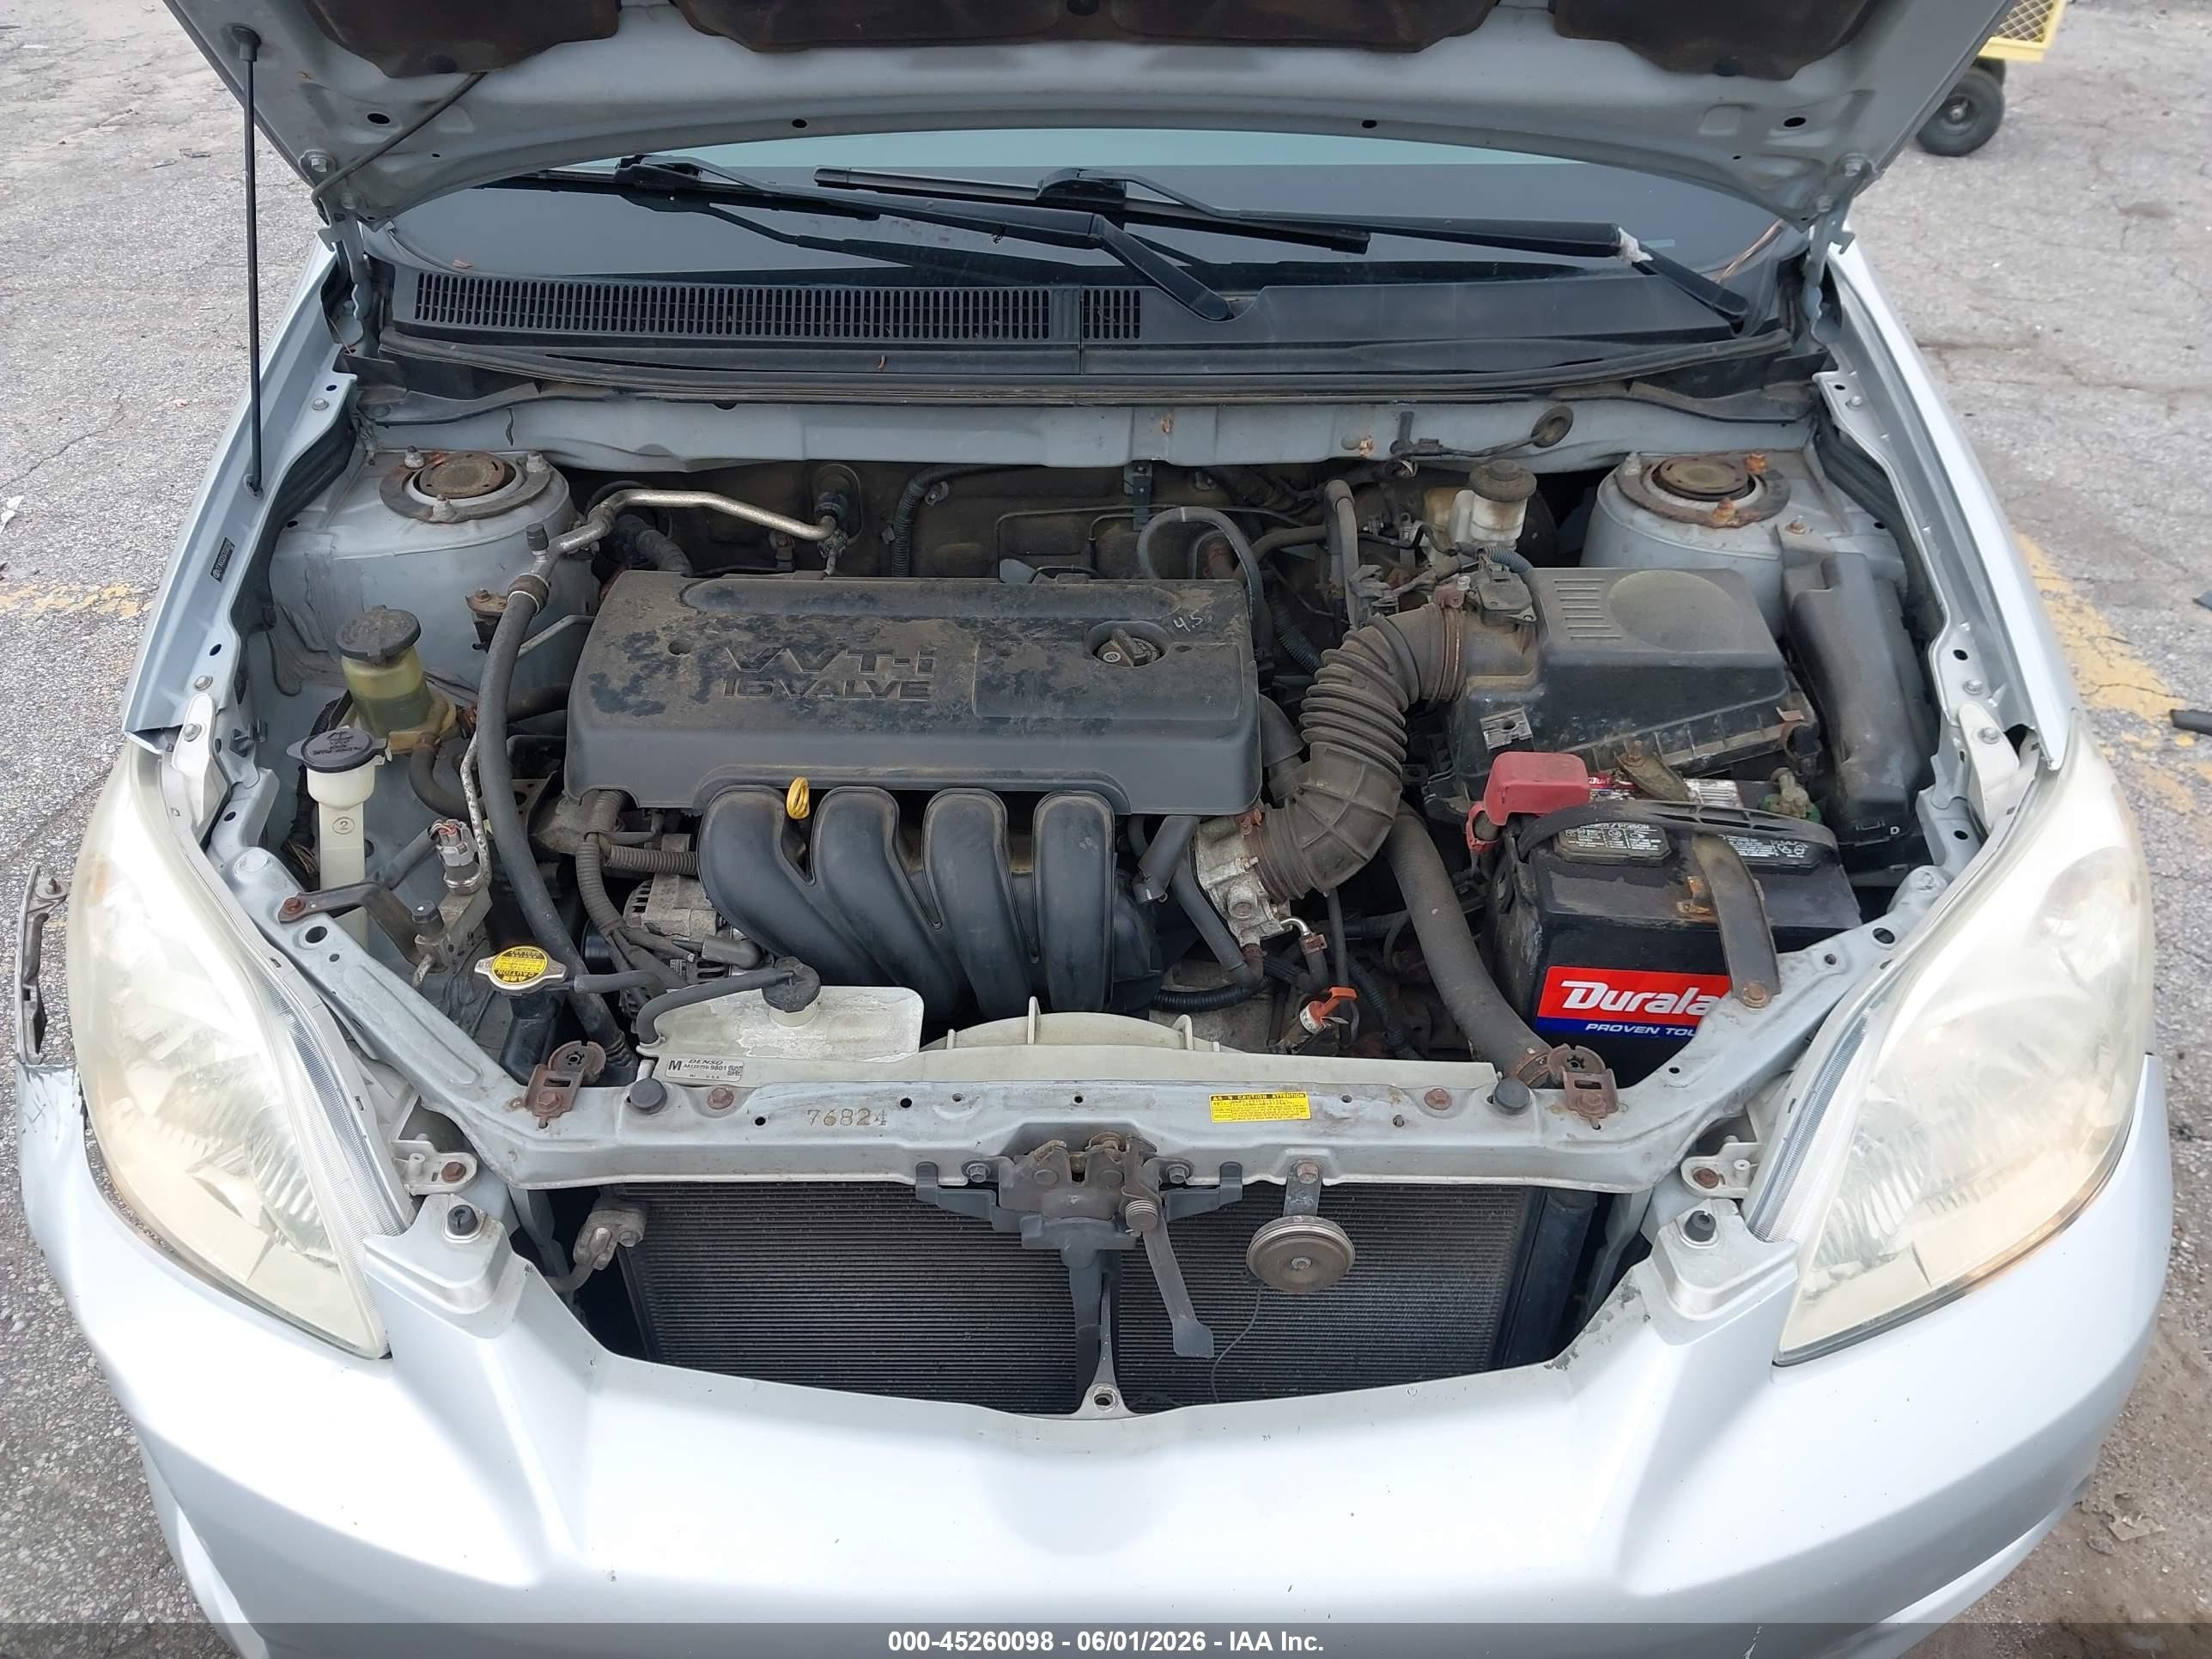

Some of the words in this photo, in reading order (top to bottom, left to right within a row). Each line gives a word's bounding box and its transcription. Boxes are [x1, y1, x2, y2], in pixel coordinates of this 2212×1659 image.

[1173, 609, 1203, 632] 4.5
[1585, 1023, 1661, 1035] PROVEN
[668, 1060, 682, 1071] M
